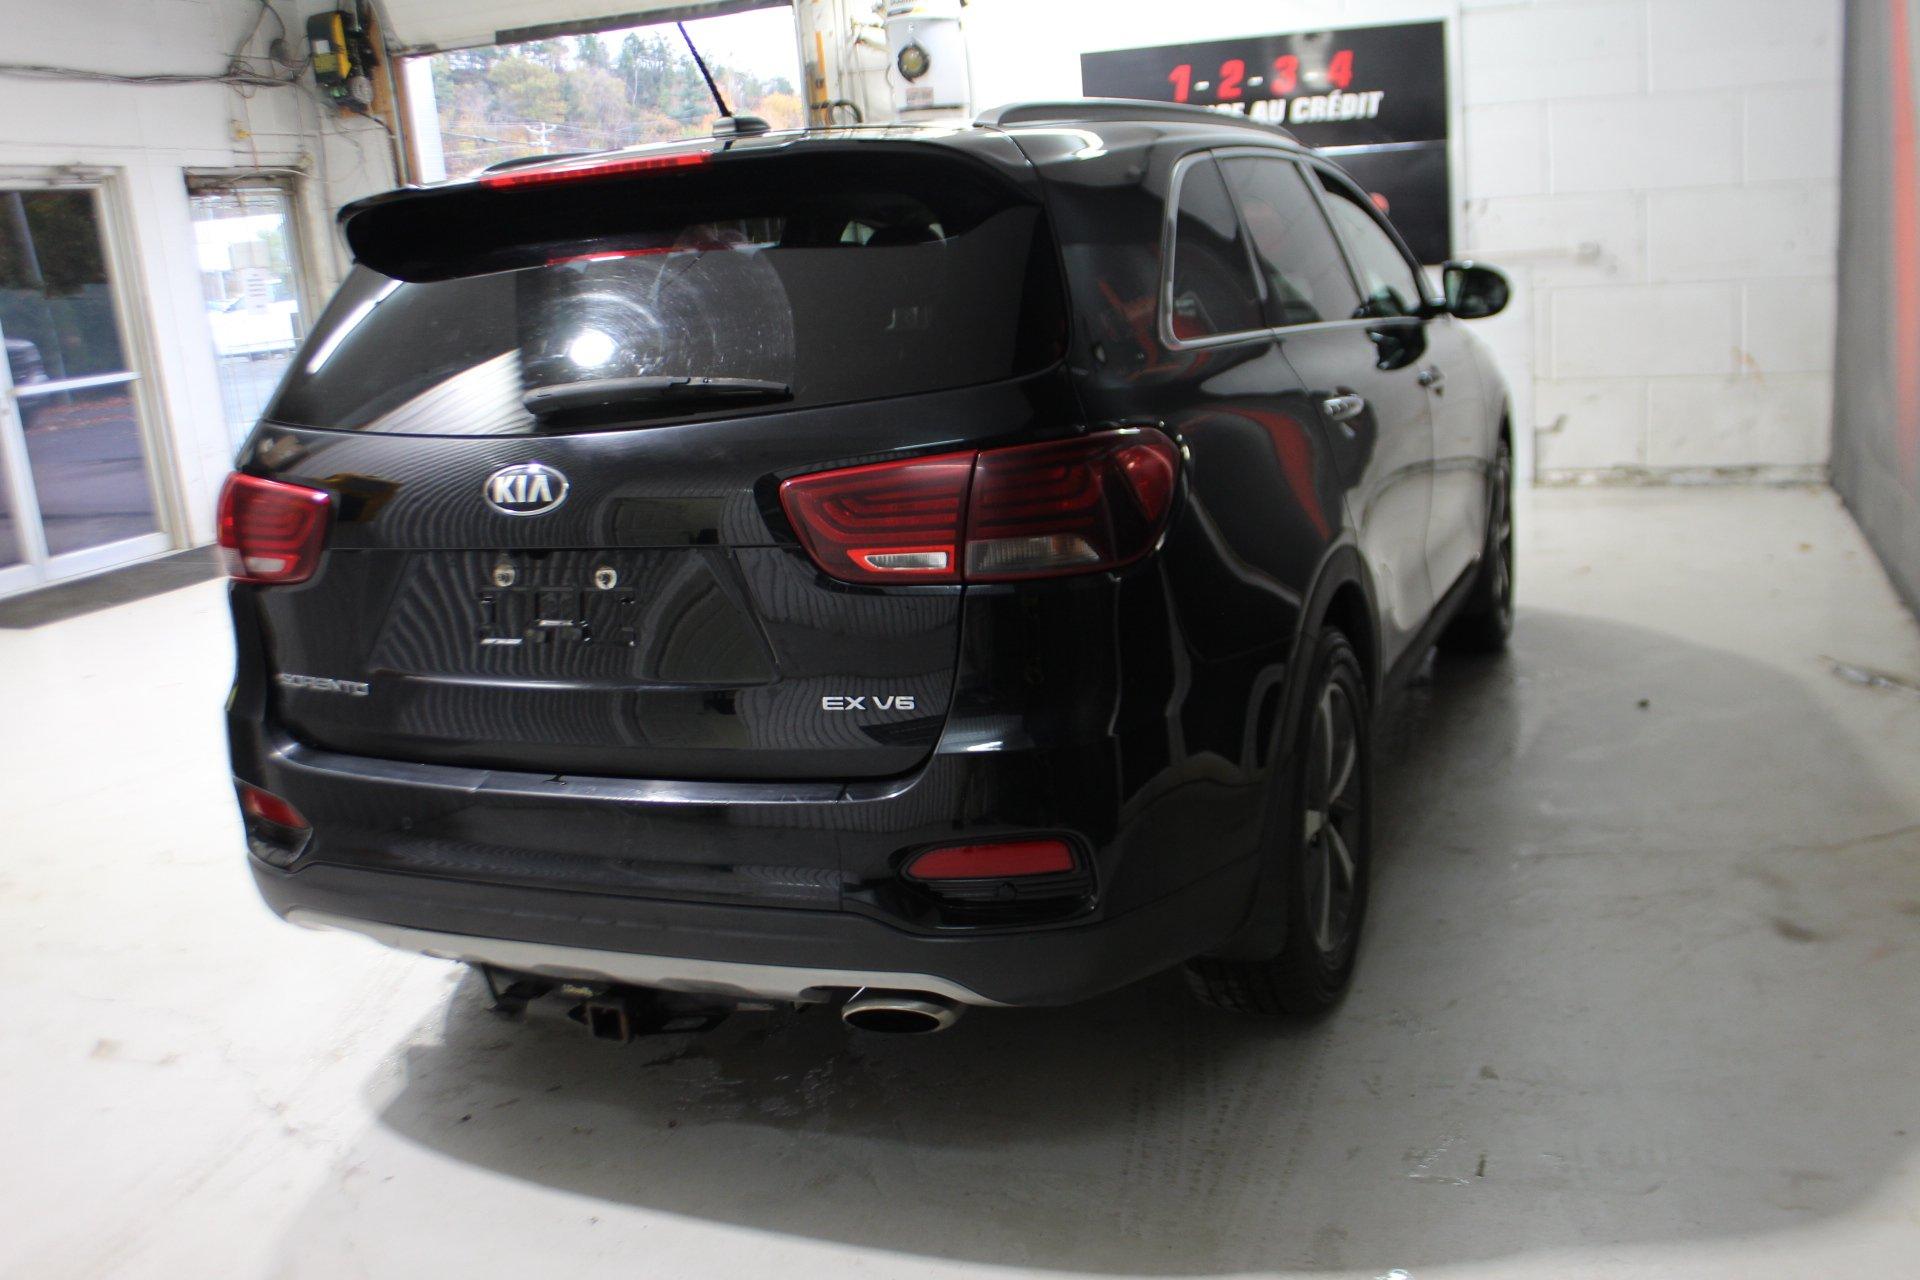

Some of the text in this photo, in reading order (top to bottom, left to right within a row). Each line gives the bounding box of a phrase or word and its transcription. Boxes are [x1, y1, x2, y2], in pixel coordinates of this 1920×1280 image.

[1249, 99, 1286, 124] AU
[1289, 89, 1384, 123] CRÉDIT
[492, 474, 553, 503] KIA
[822, 695, 915, 711] EX V6
